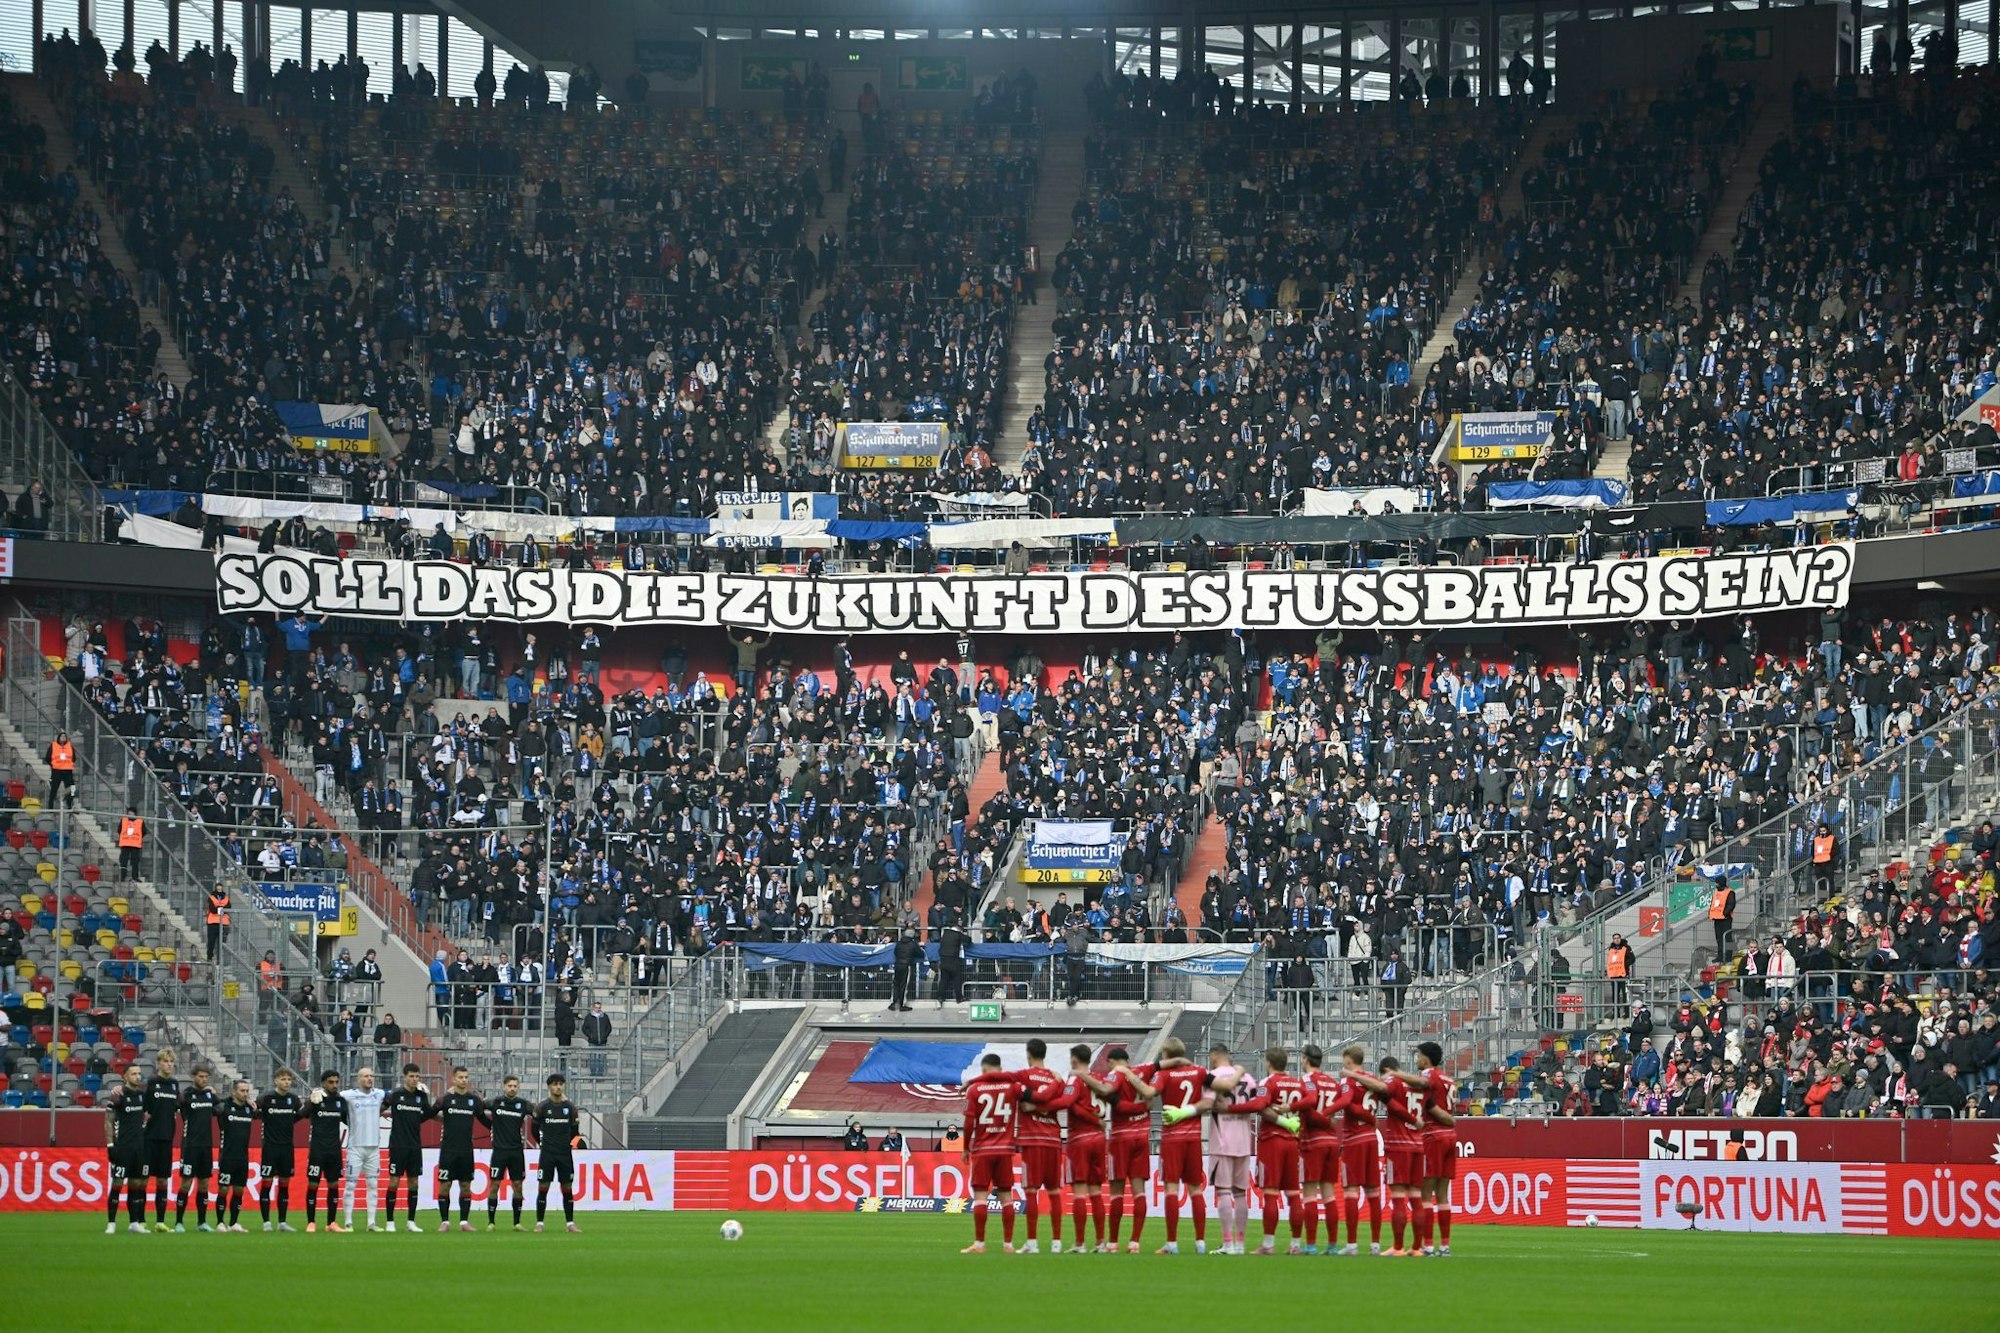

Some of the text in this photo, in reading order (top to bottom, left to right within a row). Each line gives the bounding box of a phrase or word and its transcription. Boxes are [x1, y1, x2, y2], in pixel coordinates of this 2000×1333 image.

[349, 417, 366, 431] Alt
[1464, 423, 1533, 438] Schumacher
[340, 440, 359, 452] 126
[921, 433, 938, 447] Alt
[1470, 446, 1490, 459] 129
[856, 456, 876, 467] 127
[913, 456, 933, 467] 128
[217, 545, 1851, 630] SOLL DAS DIE ZUKUNFT DES FUSSBALLS SEIN?
[1031, 843, 1106, 860] Schumacher
[1037, 869, 1052, 882] 20
[317, 894, 336, 911] Alt
[347, 911, 357, 931] 19
[1180, 1080, 1194, 1108] 2
[977, 1092, 1012, 1125] 24
[1648, 1129, 1797, 1161] METRO
[115, 1166, 126, 1178] 21
[261, 1165, 273, 1177] 27
[308, 1165, 320, 1177] 29
[389, 1163, 397, 1175] 5
[219, 1173, 231, 1185] 23
[886, 1199, 935, 1209] MERKUR
[1655, 1174, 1827, 1223] FORTUNA
